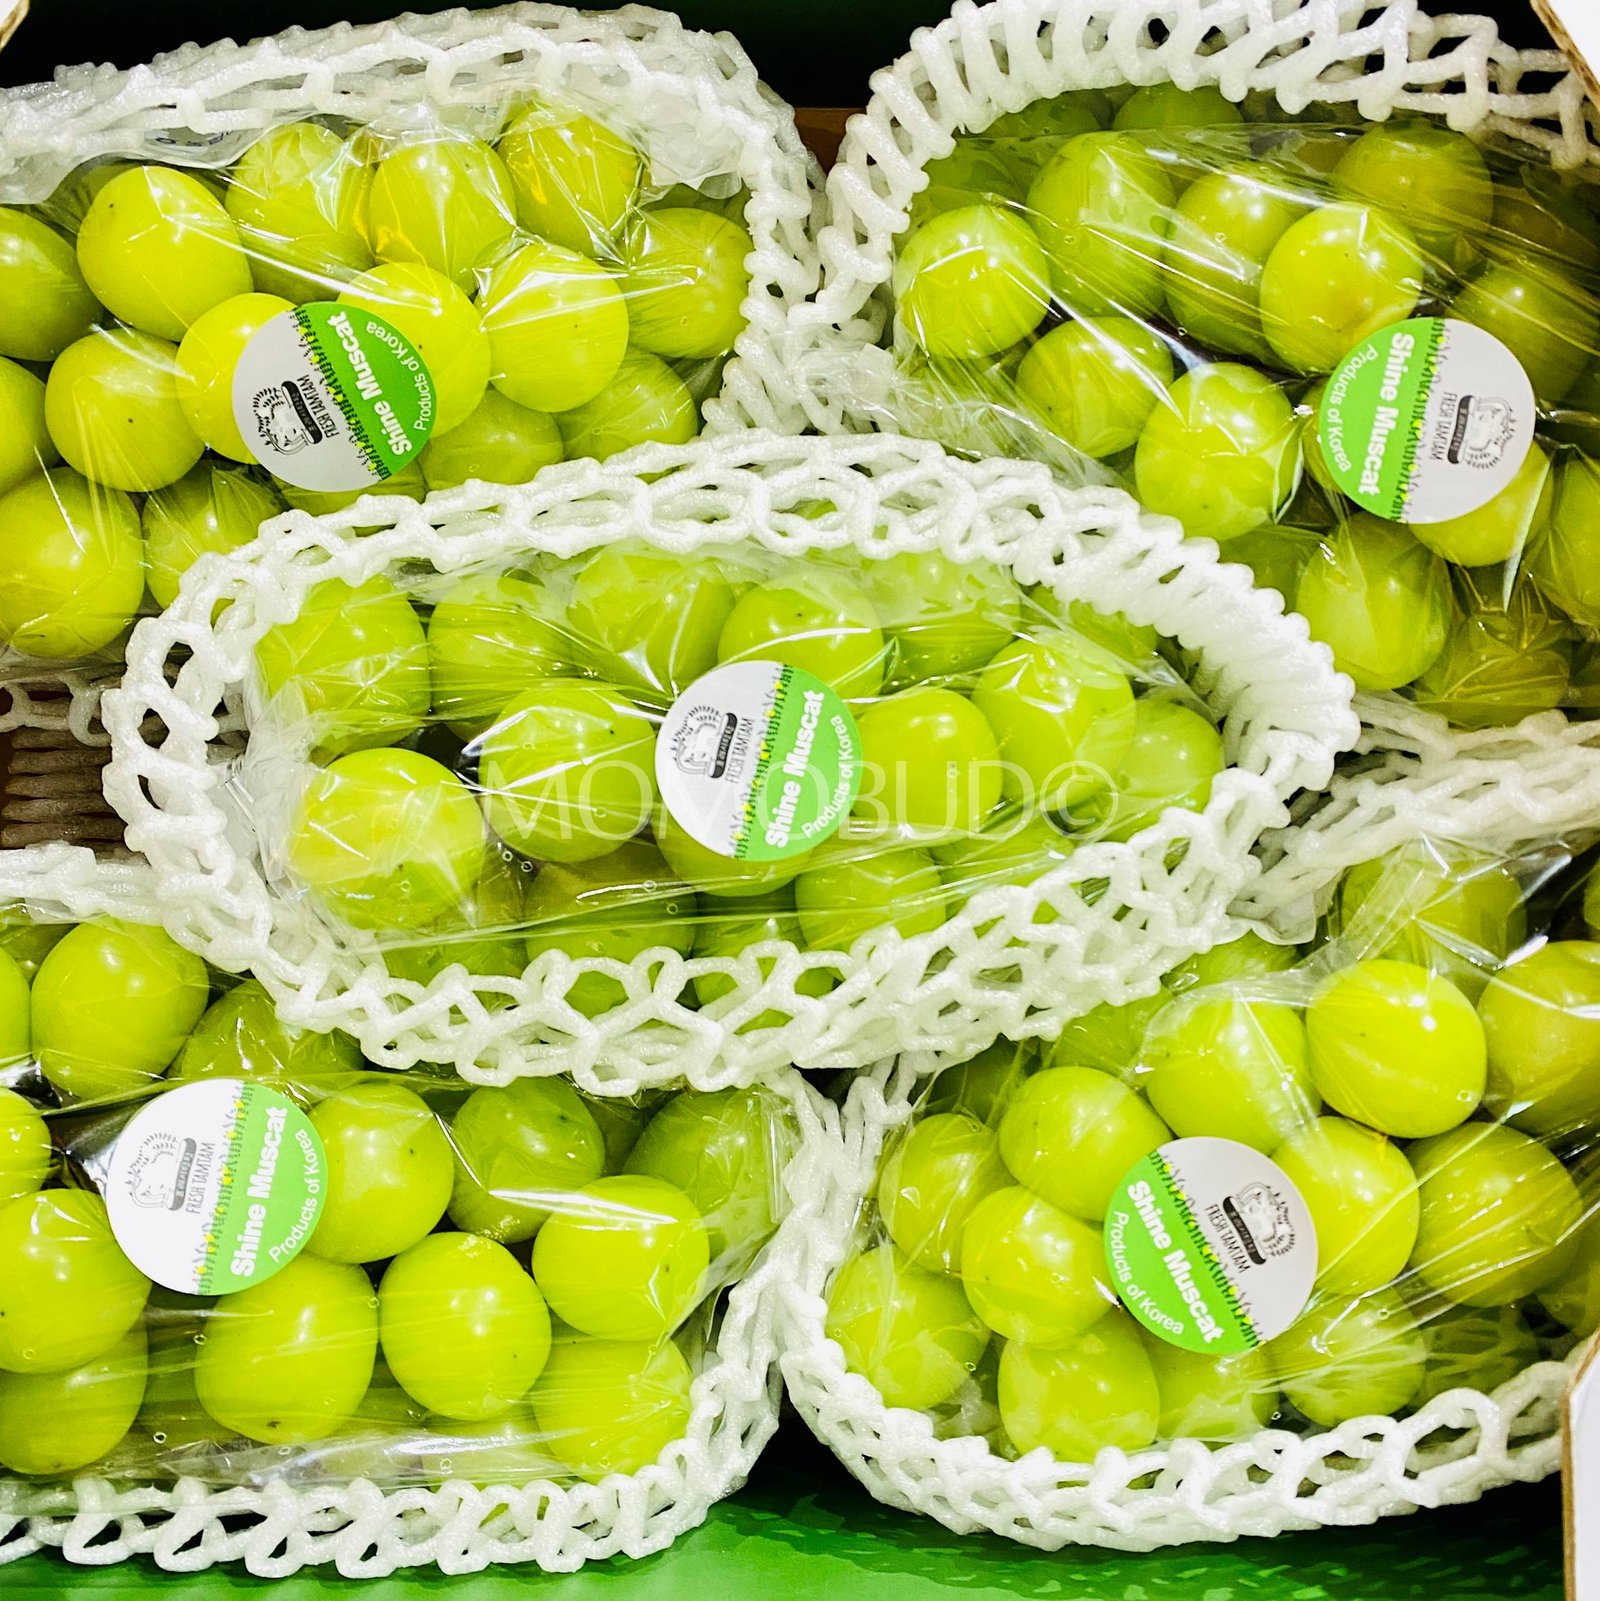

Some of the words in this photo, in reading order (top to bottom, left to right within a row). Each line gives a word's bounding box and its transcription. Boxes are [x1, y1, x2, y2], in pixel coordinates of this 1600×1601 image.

[327, 311, 383, 400] Muscat
[366, 321, 408, 359] Korea
[400, 356, 419, 371] of
[1380, 332, 1415, 401] Shine
[297, 375, 325, 417] TAMTAM
[413, 373, 432, 431] Products
[1330, 343, 1378, 404] Products
[315, 412, 339, 438] FRESH
[373, 400, 413, 455] Shine
[1328, 408, 1343, 425] of
[1328, 427, 1351, 472] Korea
[1358, 405, 1399, 495] Muscat
[725, 757, 744, 784] FRESH
[736, 717, 755, 757] TAMTAM
[830, 714, 853, 760] Korea
[765, 781, 800, 848] Shine
[783, 690, 825, 777] Muscat
[839, 762, 853, 778] of
[801, 782, 851, 839] Products
[192, 1142, 215, 1184] TAMTAM
[247, 1106, 288, 1199] Muscat
[295, 1129, 320, 1175] Korea
[186, 1184, 206, 1214] FRESH
[303, 1175, 319, 1194] of
[230, 1203, 266, 1277] Shine
[268, 1197, 317, 1263] Products
[1204, 1203, 1226, 1232] FRESH
[1218, 1228, 1250, 1274] TAMTAM
[1110, 1211, 1132, 1283] Products
[1126, 1284, 1146, 1300] of
[1139, 1298, 1184, 1335] Korea
[1128, 1180, 1172, 1249] Shine
[1163, 1249, 1224, 1344] Muscat
